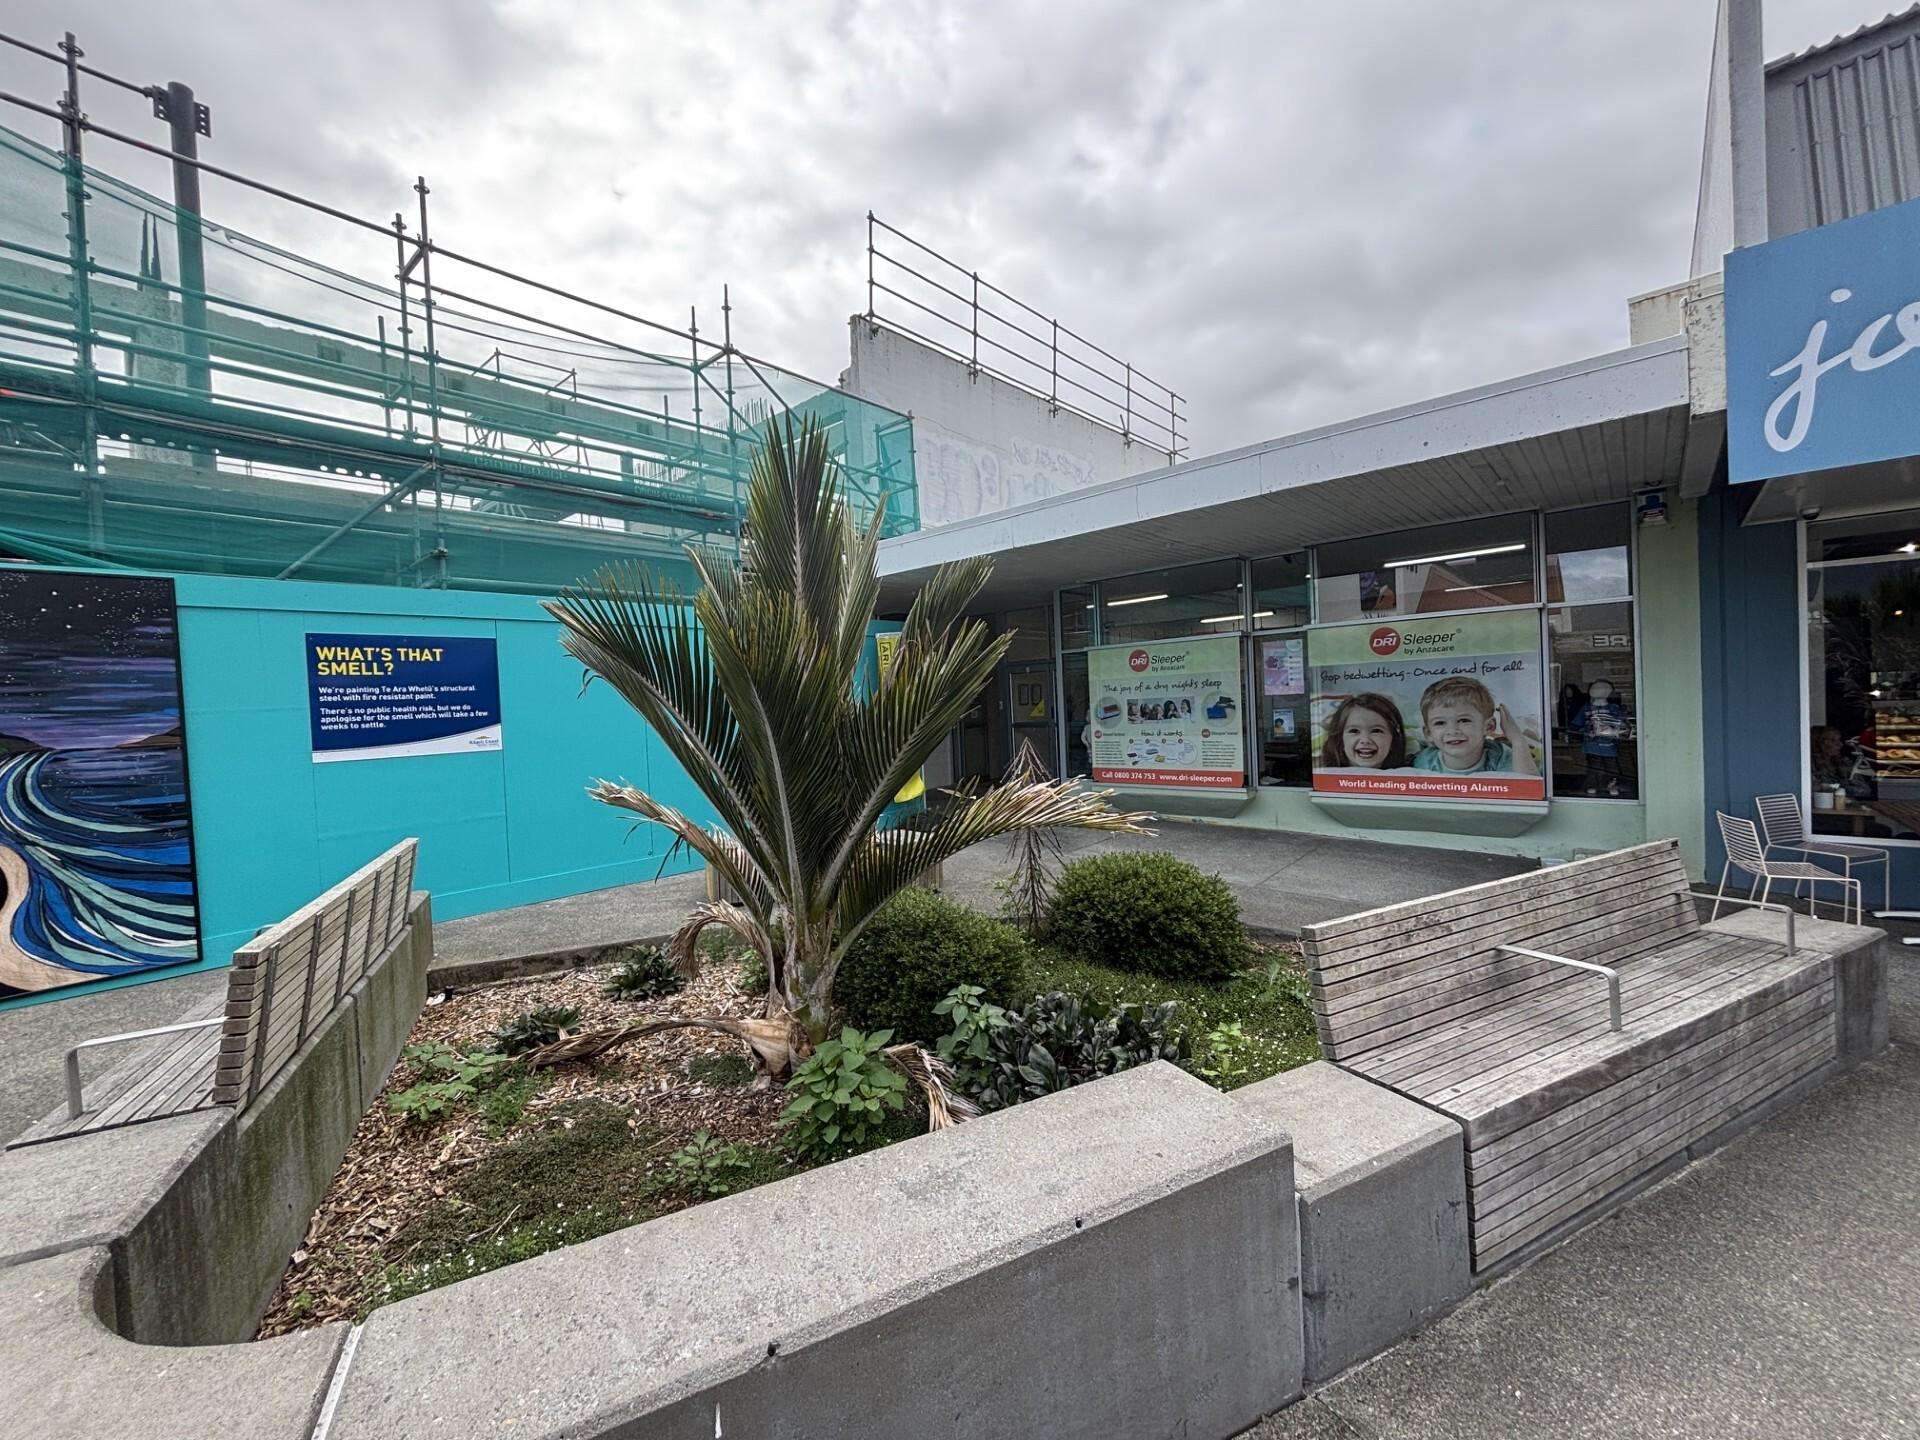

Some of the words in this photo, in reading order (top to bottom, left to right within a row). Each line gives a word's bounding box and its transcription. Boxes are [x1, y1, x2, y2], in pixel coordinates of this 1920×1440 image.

[1373, 634, 1397, 648] DRI
[1403, 632, 1456, 645] Sleeper
[315, 646, 393, 661] WHAT'S
[397, 648, 443, 661] THAT
[1131, 654, 1148, 666] DRI
[1151, 653, 1186, 665] Sleeper
[317, 662, 394, 676] SMELL?
[1320, 670, 1341, 685] Stop
[1413, 668, 1447, 676] Once
[1451, 662, 1477, 674] and
[1481, 661, 1500, 676] for
[1503, 660, 1525, 672] all
[318, 686, 345, 694] We're
[346, 686, 380, 695] painting
[1120, 684, 1131, 694] joy
[1135, 682, 1144, 692] of
[1154, 681, 1168, 692] dry
[1201, 679, 1223, 690] sleep
[415, 693, 436, 701] paint.
[320, 707, 353, 715] There's
[366, 706, 391, 715] public
[393, 705, 417, 713] health
[320, 715, 362, 724] apologise
[1339, 779, 1366, 788] World
[1368, 780, 1406, 791] Leading
[1408, 781, 1467, 793] Bedwetting
[1470, 783, 1509, 793] Alarms
